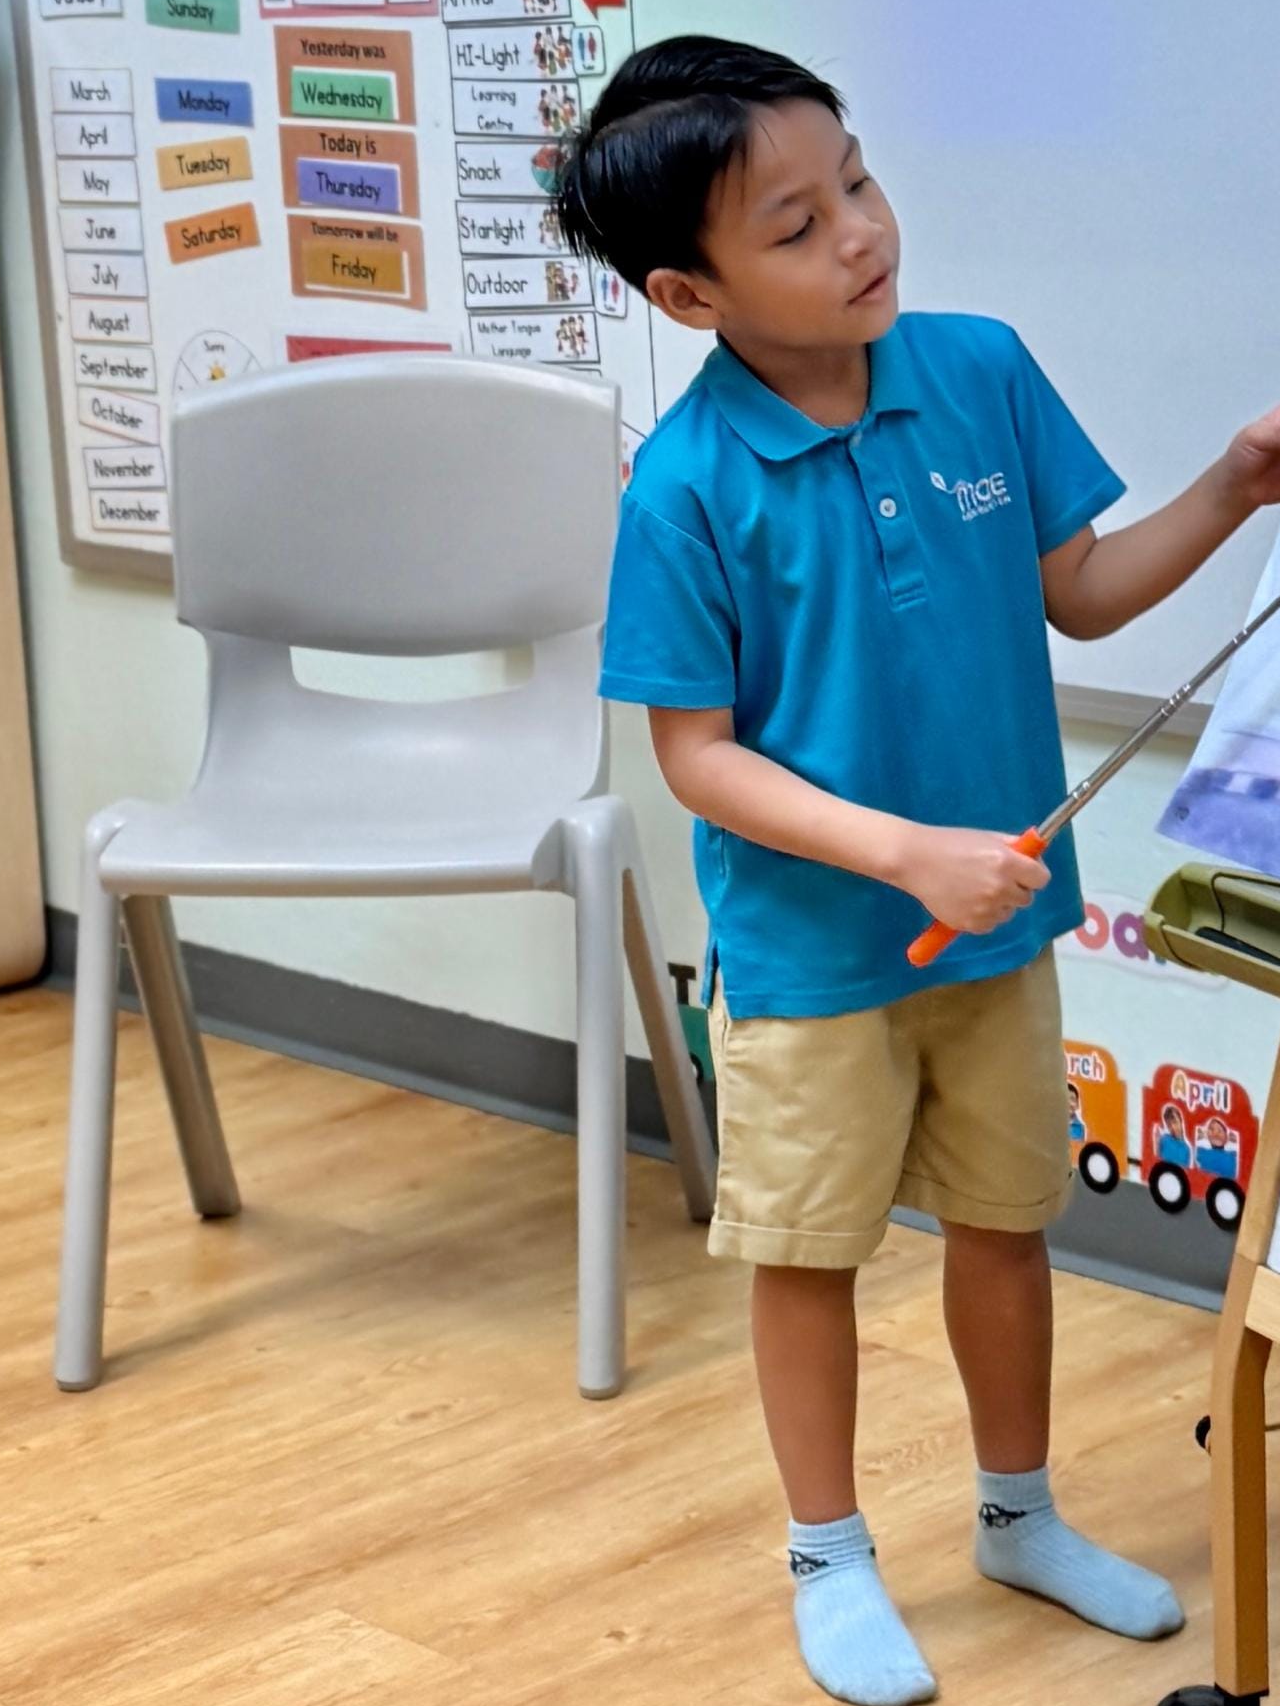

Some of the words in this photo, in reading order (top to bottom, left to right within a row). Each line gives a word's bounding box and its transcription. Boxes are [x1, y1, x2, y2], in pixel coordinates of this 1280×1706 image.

[300, 39, 360, 63] Yesterday
[360, 43, 386, 60] was
[70, 80, 111, 102] March
[178, 90, 231, 116] Monday
[299, 81, 383, 112] Wednesday
[79, 125, 108, 148] April
[319, 132, 363, 156] Today
[365, 137, 377, 155] is
[175, 154, 232, 179] Tuesday
[457, 159, 502, 182] Snack
[83, 171, 110, 195] May
[316, 170, 381, 202] Thursday
[84, 218, 116, 240] June
[181, 221, 242, 250] Saturday
[460, 215, 526, 245] Starlight
[91, 263, 119, 291] July
[331, 253, 378, 283] Friday
[466, 271, 528, 294] Outdoor
[88, 313, 130, 336] August
[80, 355, 148, 380] September
[92, 398, 144, 430] October
[93, 457, 155, 478] November
[99, 499, 161, 523] December
[1066, 1054, 1105, 1081] rch
[1172, 1071, 1230, 1111] April
